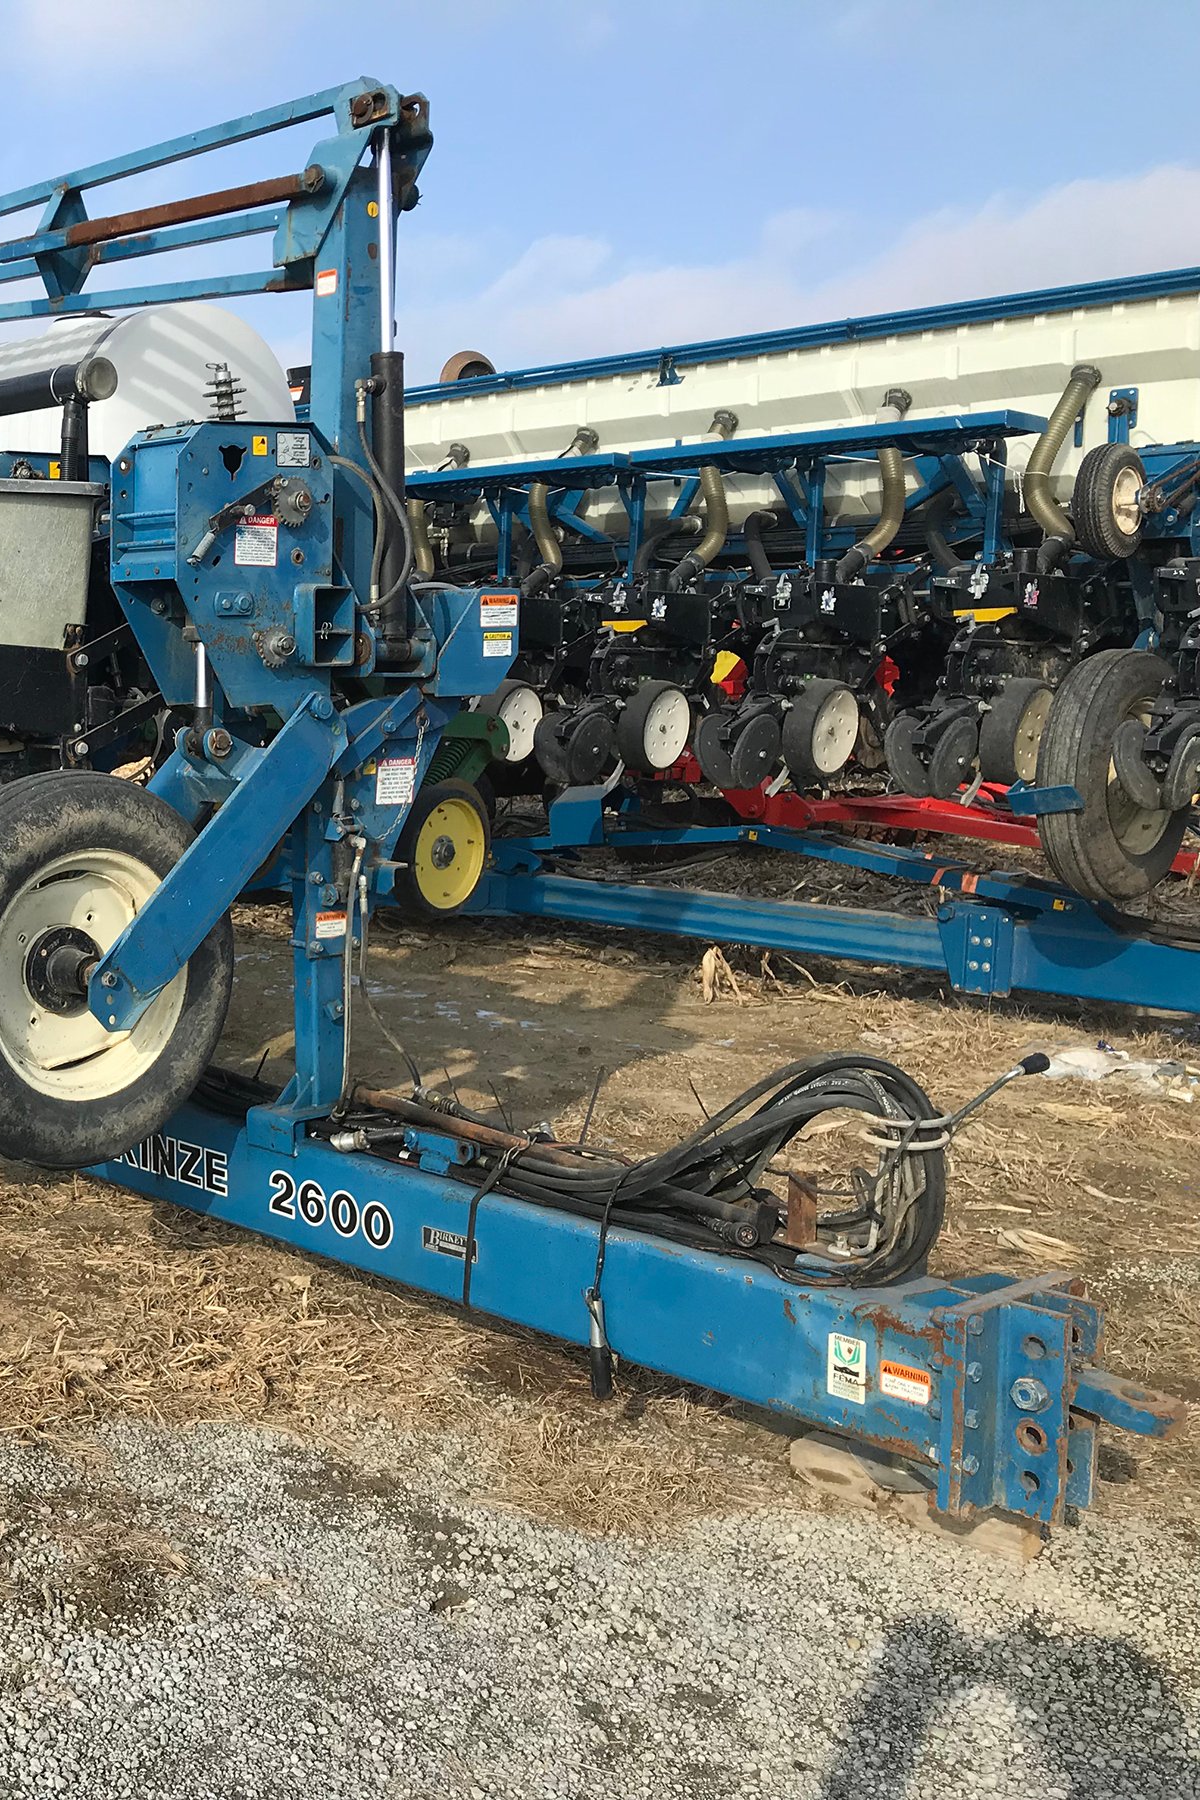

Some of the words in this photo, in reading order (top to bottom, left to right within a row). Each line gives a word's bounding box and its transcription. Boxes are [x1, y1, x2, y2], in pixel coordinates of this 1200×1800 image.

[248, 516, 275, 525] DANGER
[113, 1134, 228, 1197] INZE
[269, 1169, 394, 1250] 2600
[834, 1335, 860, 1346] MEMBER
[833, 1372, 859, 1386] FEMA
[892, 1366, 929, 1384] WARNING
